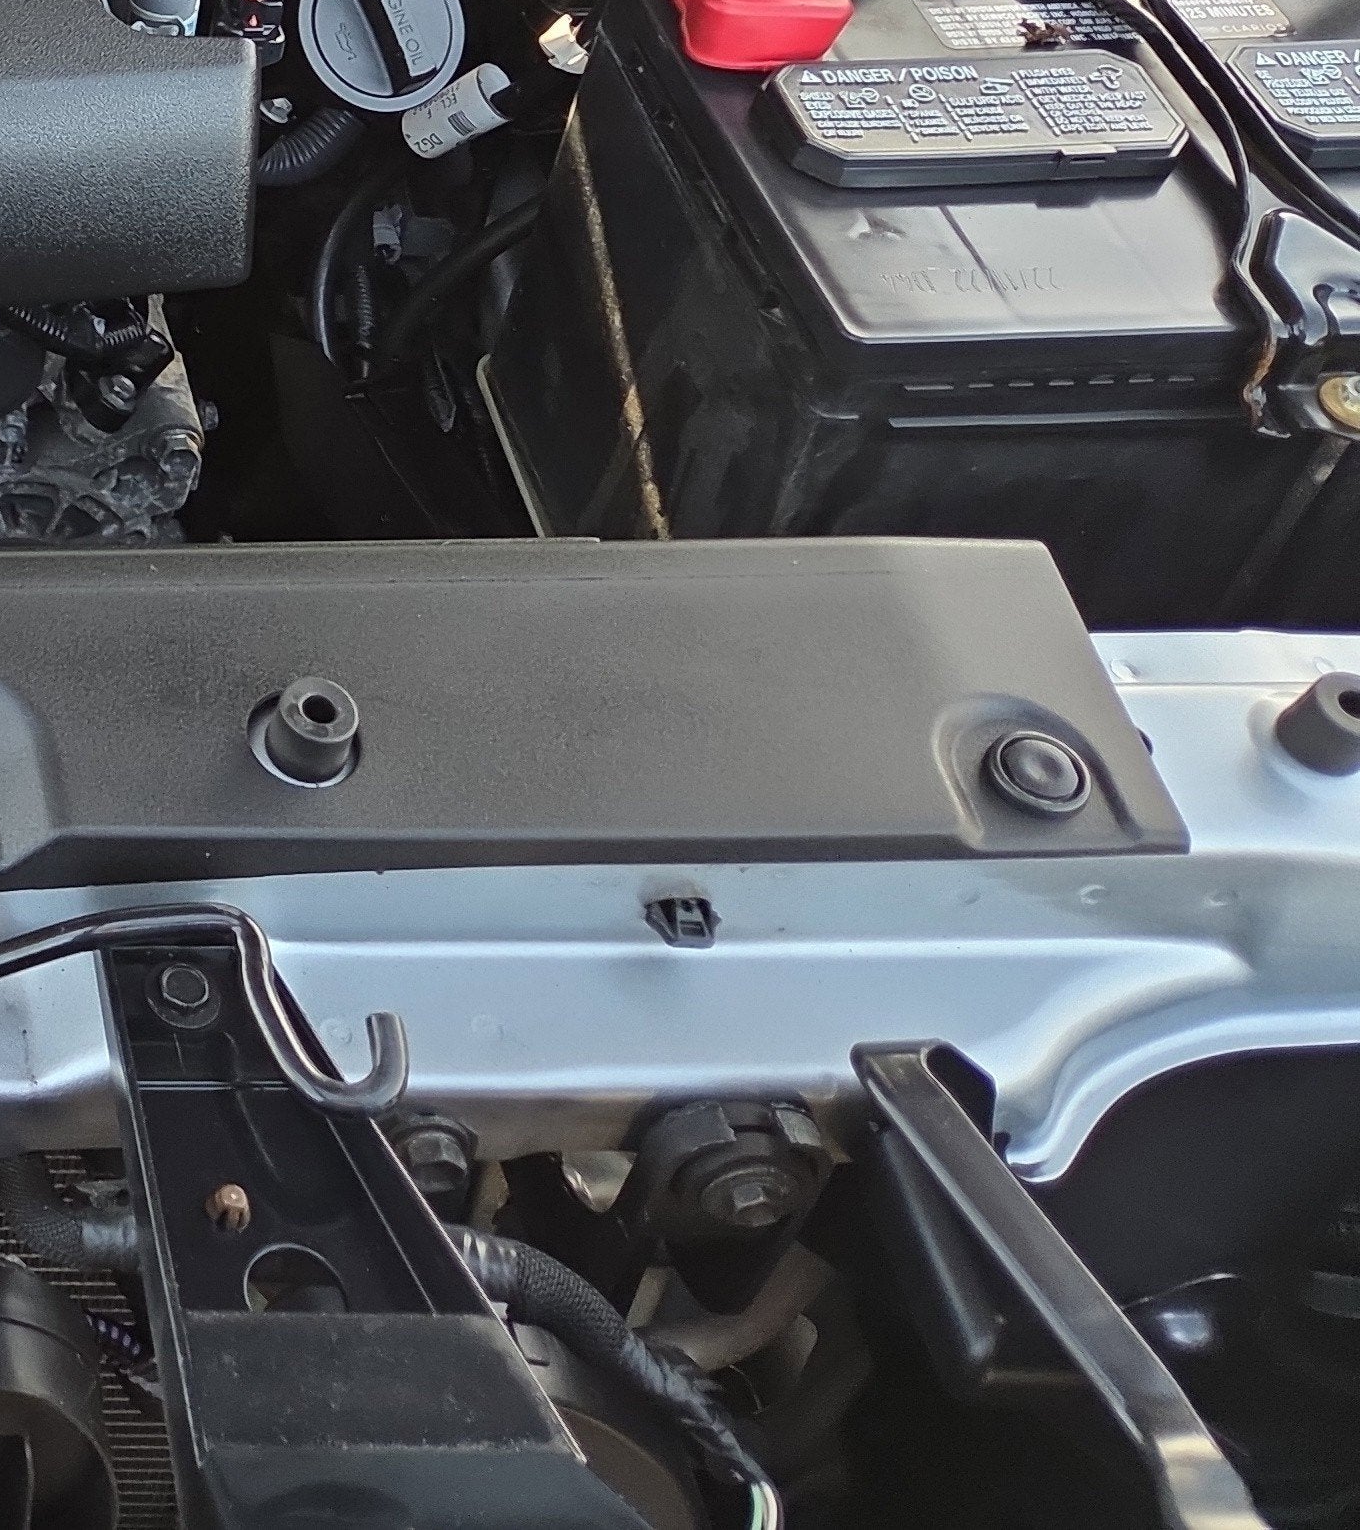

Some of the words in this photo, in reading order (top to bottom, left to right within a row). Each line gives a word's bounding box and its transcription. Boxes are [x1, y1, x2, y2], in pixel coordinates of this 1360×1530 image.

[1205, 3, 1276, 19] MINUTES
[1221, 22, 1288, 33] CLARIOS
[405, 38, 424, 66] OIL
[1274, 49, 1353, 67] DANGER
[820, 67, 898, 85] DANGER
[908, 65, 979, 83] POISON
[413, 132, 444, 154] DG2
